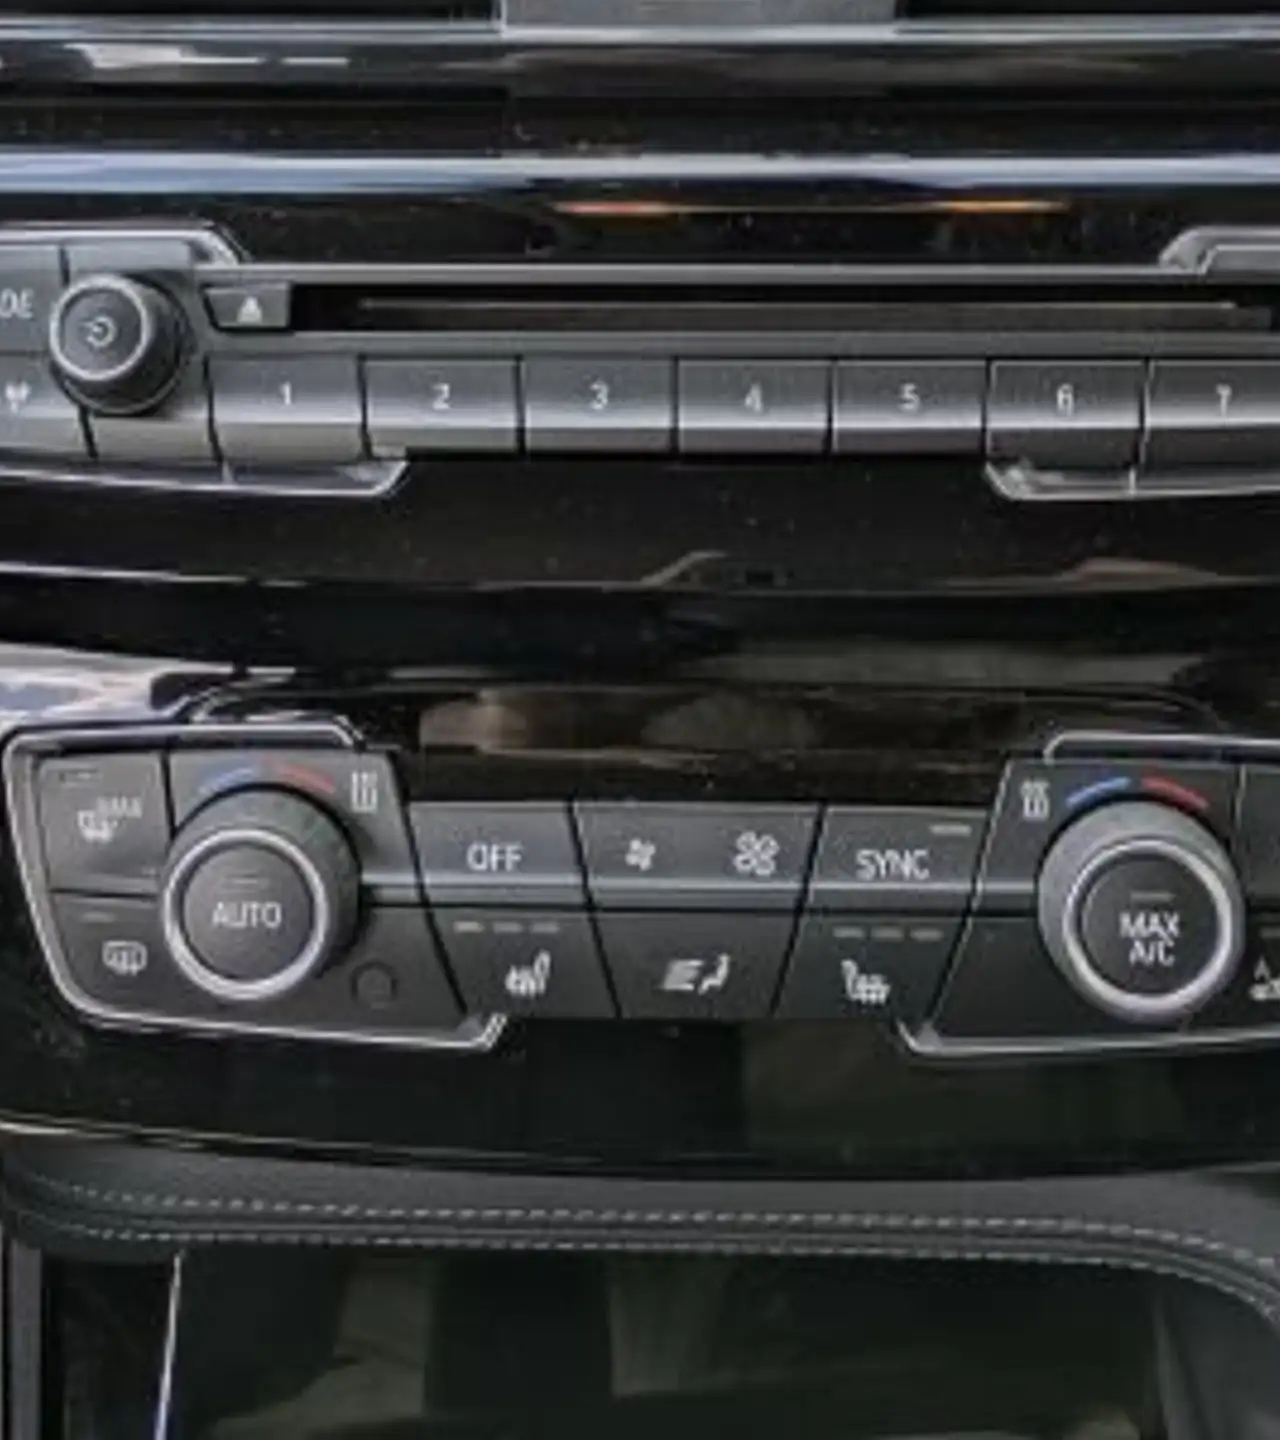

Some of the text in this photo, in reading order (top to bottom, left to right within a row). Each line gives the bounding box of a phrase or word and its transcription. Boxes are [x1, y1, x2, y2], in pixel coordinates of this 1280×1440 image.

[280, 382, 293, 405] 1
[433, 383, 451, 410] 2
[591, 382, 609, 409] 3
[744, 384, 762, 411] 4
[902, 383, 920, 411] 5
[1056, 383, 1074, 411] 6
[1216, 384, 1233, 412] 7
[466, 843, 523, 871] OFF
[855, 850, 930, 881] SYNC
[212, 901, 282, 929] AUTO
[1120, 912, 1179, 939] MAX
[1128, 939, 1176, 966] A/C
